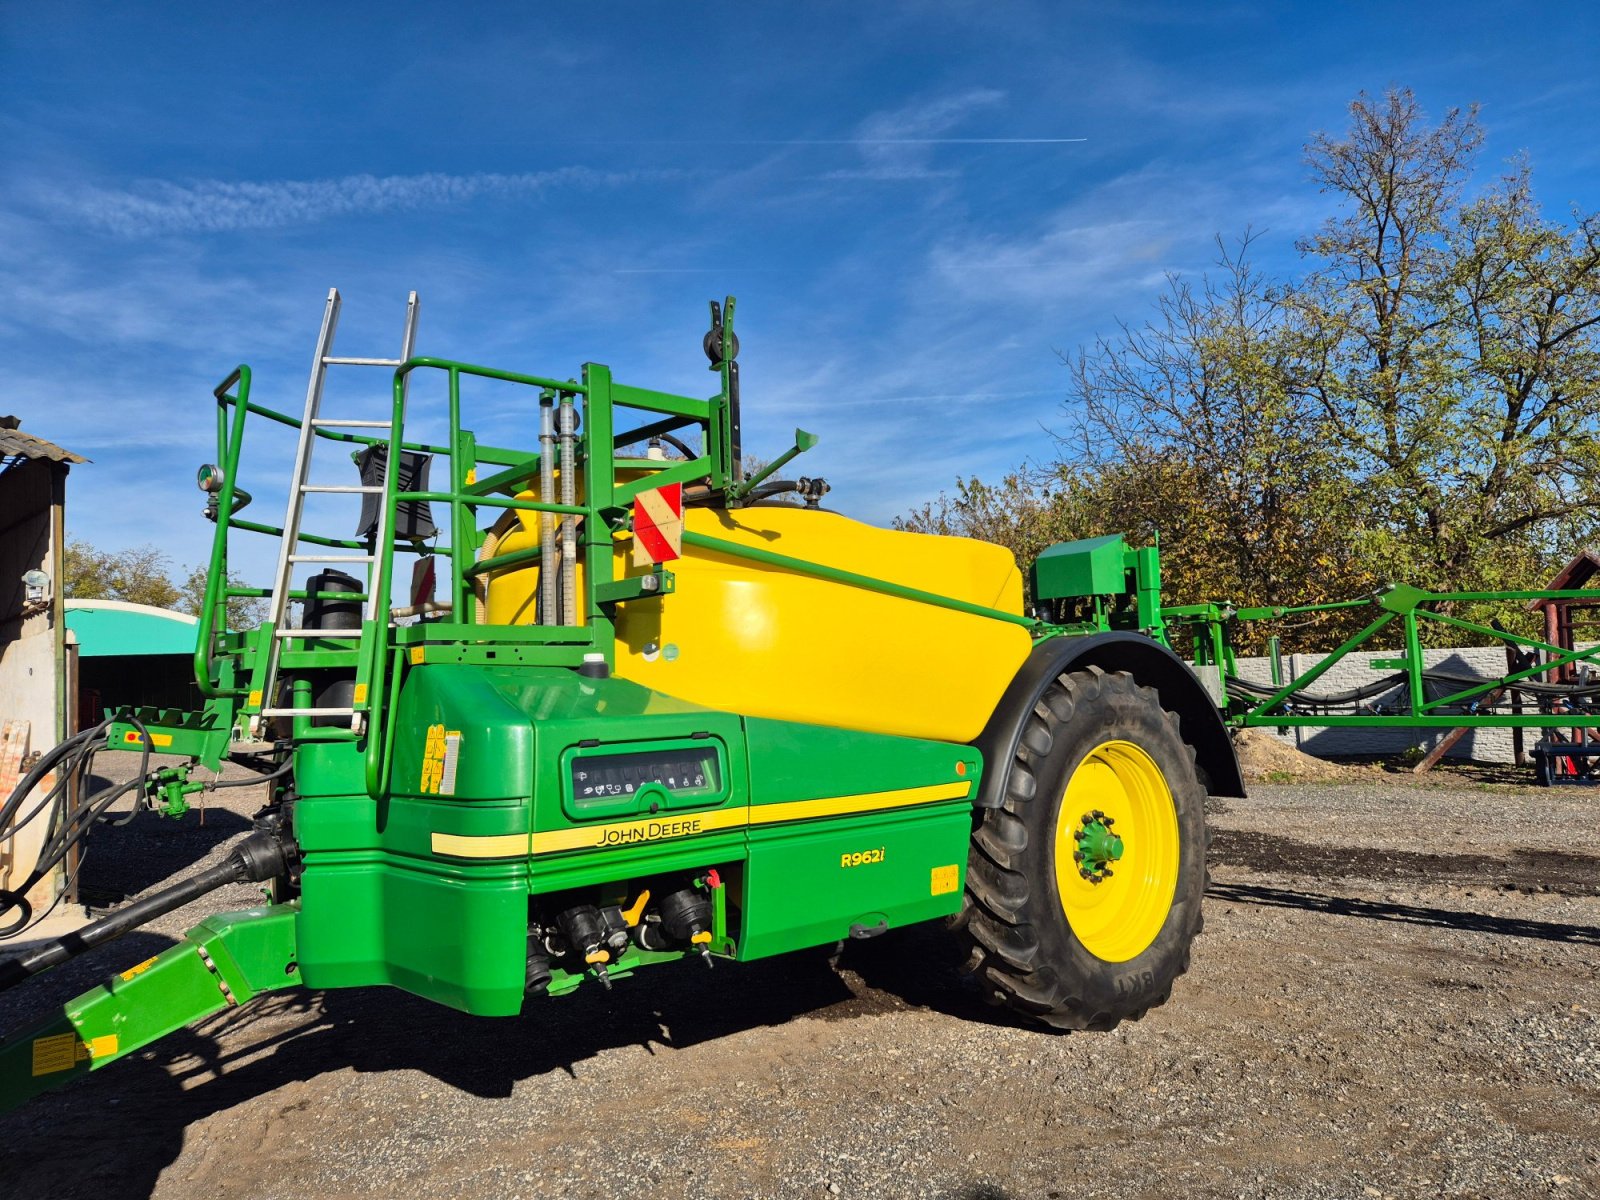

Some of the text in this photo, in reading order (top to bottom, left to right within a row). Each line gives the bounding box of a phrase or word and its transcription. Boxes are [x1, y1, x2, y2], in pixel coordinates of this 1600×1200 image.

[597, 820, 701, 845] JOHN DEERE
[841, 846, 885, 868] R962i
[1117, 972, 1153, 995] BKT
